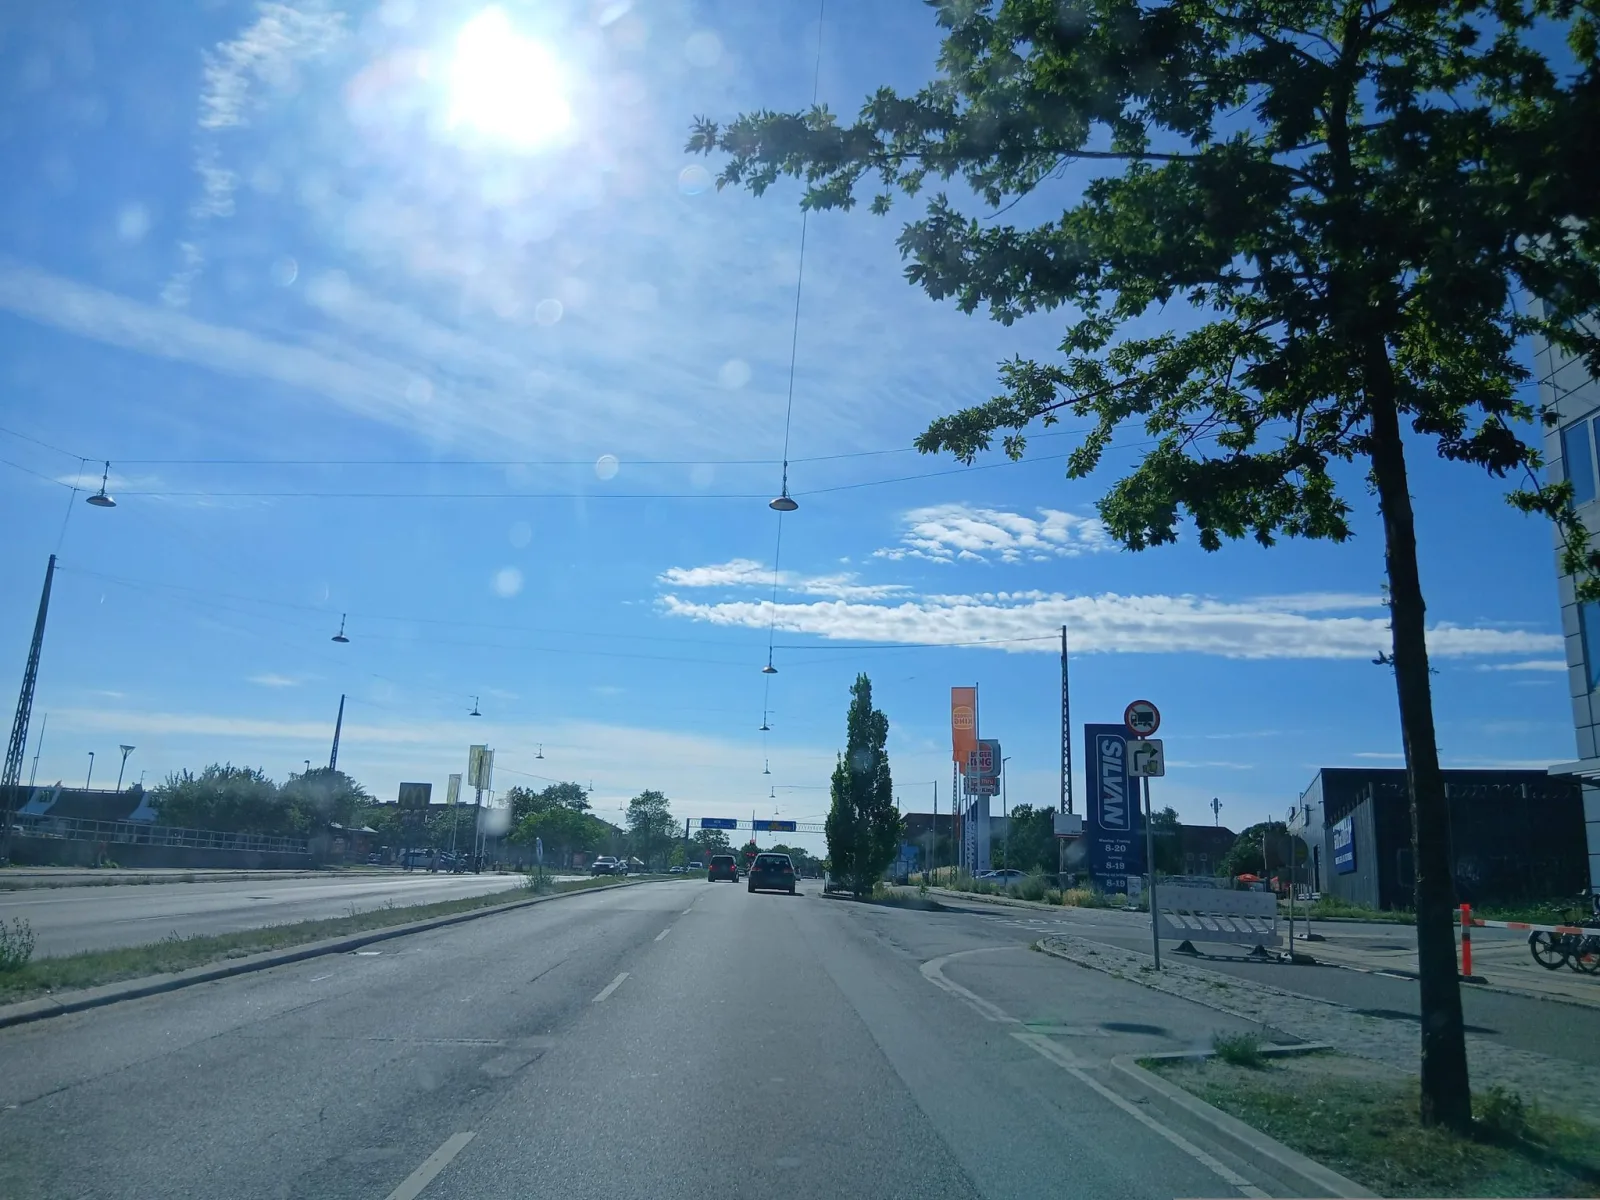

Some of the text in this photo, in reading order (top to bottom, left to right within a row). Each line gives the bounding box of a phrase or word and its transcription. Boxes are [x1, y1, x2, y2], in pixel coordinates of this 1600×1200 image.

[1101, 739, 1124, 826] SILVAN
[1105, 844, 1126, 852] 8-20
[1105, 861, 1125, 870] 8-19
[1106, 879, 1126, 887] 8-19
